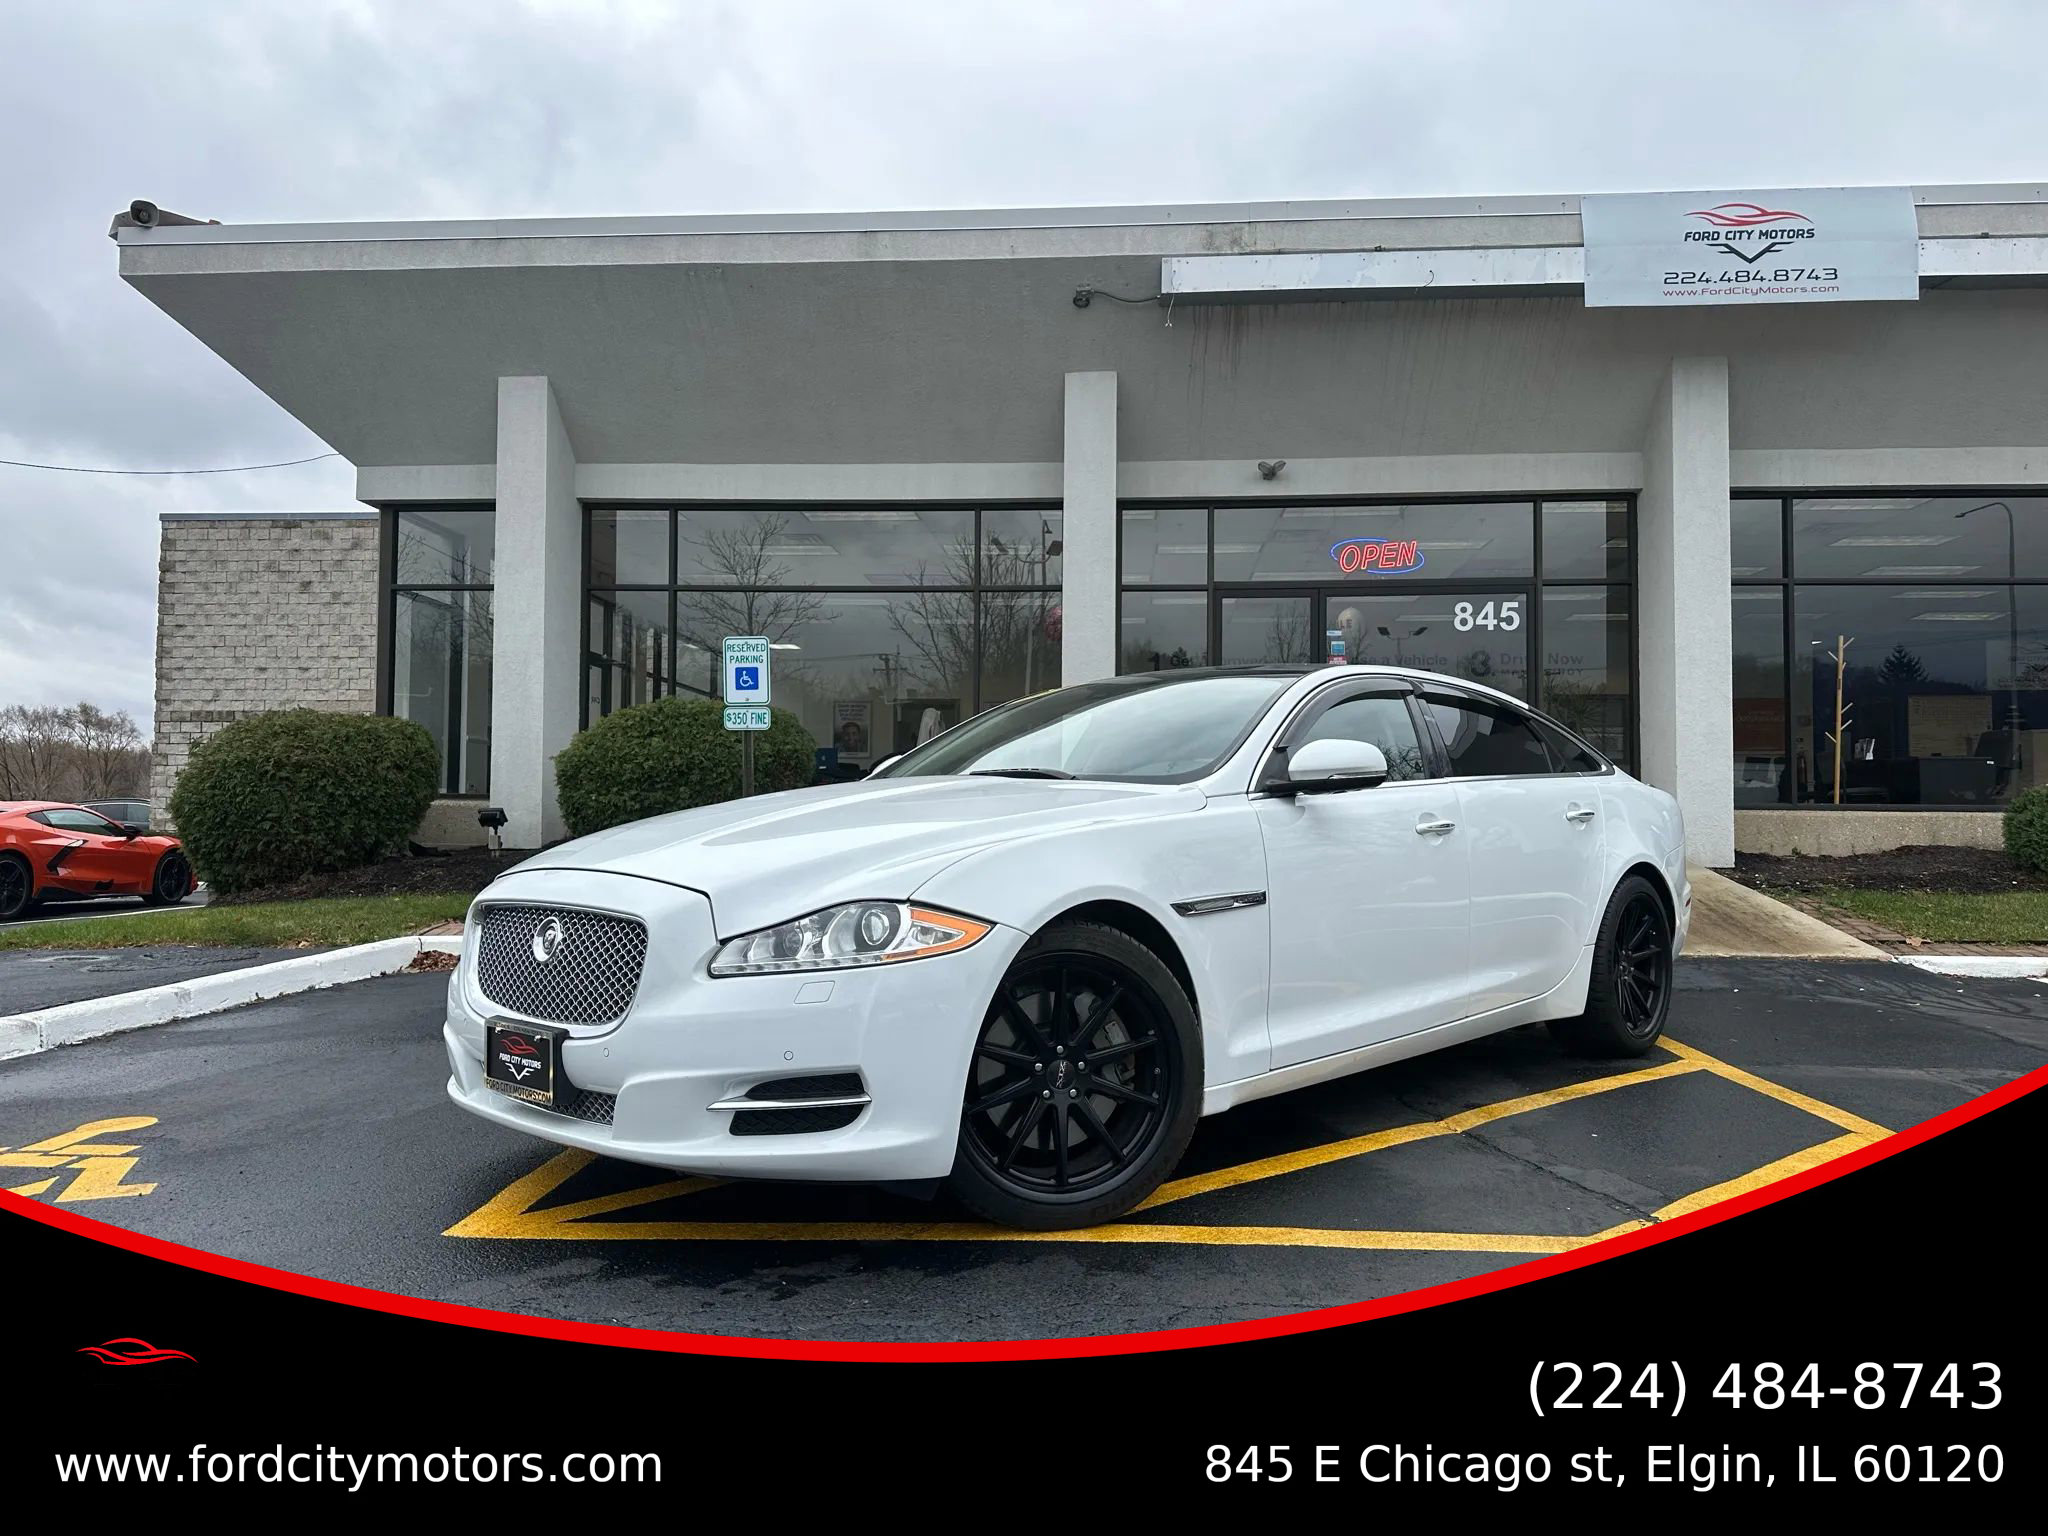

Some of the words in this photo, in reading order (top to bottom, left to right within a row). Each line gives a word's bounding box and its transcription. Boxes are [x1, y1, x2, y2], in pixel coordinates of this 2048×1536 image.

[1684, 230, 1720, 242] FORD
[1724, 229, 1755, 241] CITY
[1758, 228, 1815, 240] MOTORS
[1663, 268, 1838, 285] 224.484.8743
[1662, 284, 1840, 297] www.FordCityMotors.com
[1339, 540, 1418, 573] OPEN
[1453, 601, 1520, 631] 845
[726, 643, 766, 652] RESERVED
[729, 655, 764, 664] PARKING
[726, 712, 748, 725] $350
[750, 712, 767, 725] FINE
[499, 1053, 511, 1062] FORD
[511, 1056, 521, 1064] CITY
[521, 1058, 542, 1069] MOTORS
[486, 1078, 500, 1090] FORD
